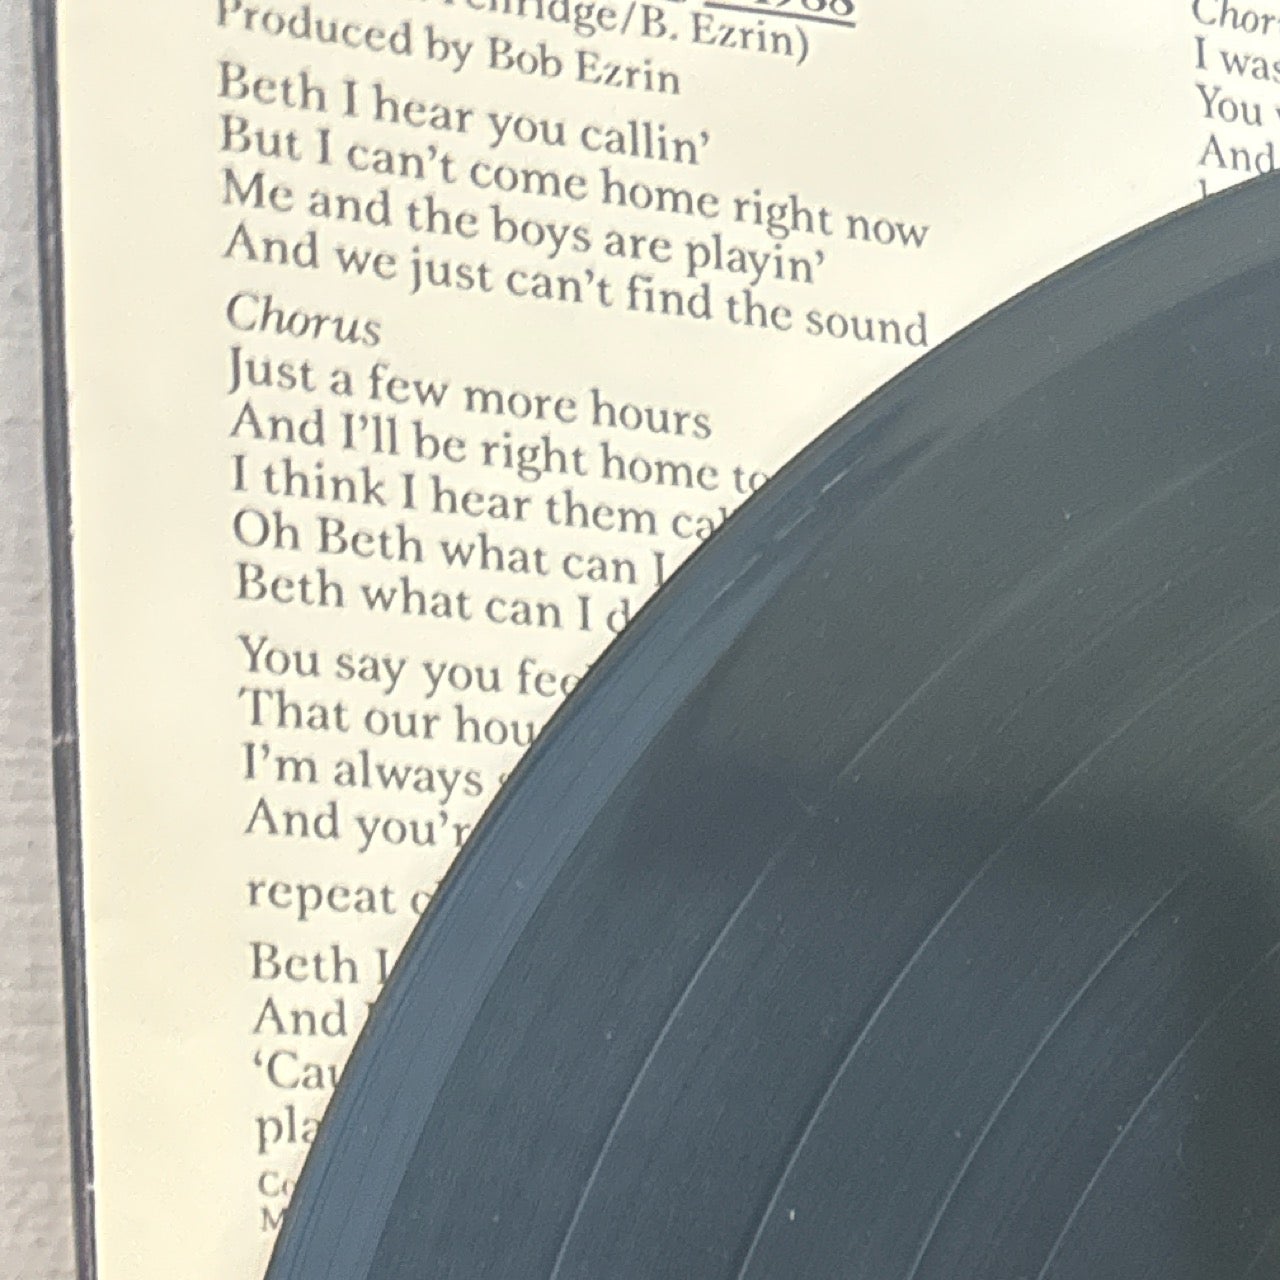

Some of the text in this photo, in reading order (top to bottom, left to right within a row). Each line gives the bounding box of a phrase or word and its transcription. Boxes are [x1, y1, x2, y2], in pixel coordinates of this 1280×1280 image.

[424, 24, 679, 94] by Bob Ezrin
[1193, 36, 1208, 71] I
[218, 61, 709, 165] Beth I hear you callin'
[1195, 83, 1264, 127] You
[221, 114, 929, 248] But I can't come home right now
[227, 291, 381, 346] Chorus
[228, 346, 712, 439] Just a few more hours
[238, 634, 501, 699] You say you
[238, 687, 441, 739] That our
[244, 741, 483, 806] I'm always
[247, 881, 396, 921] repeat
